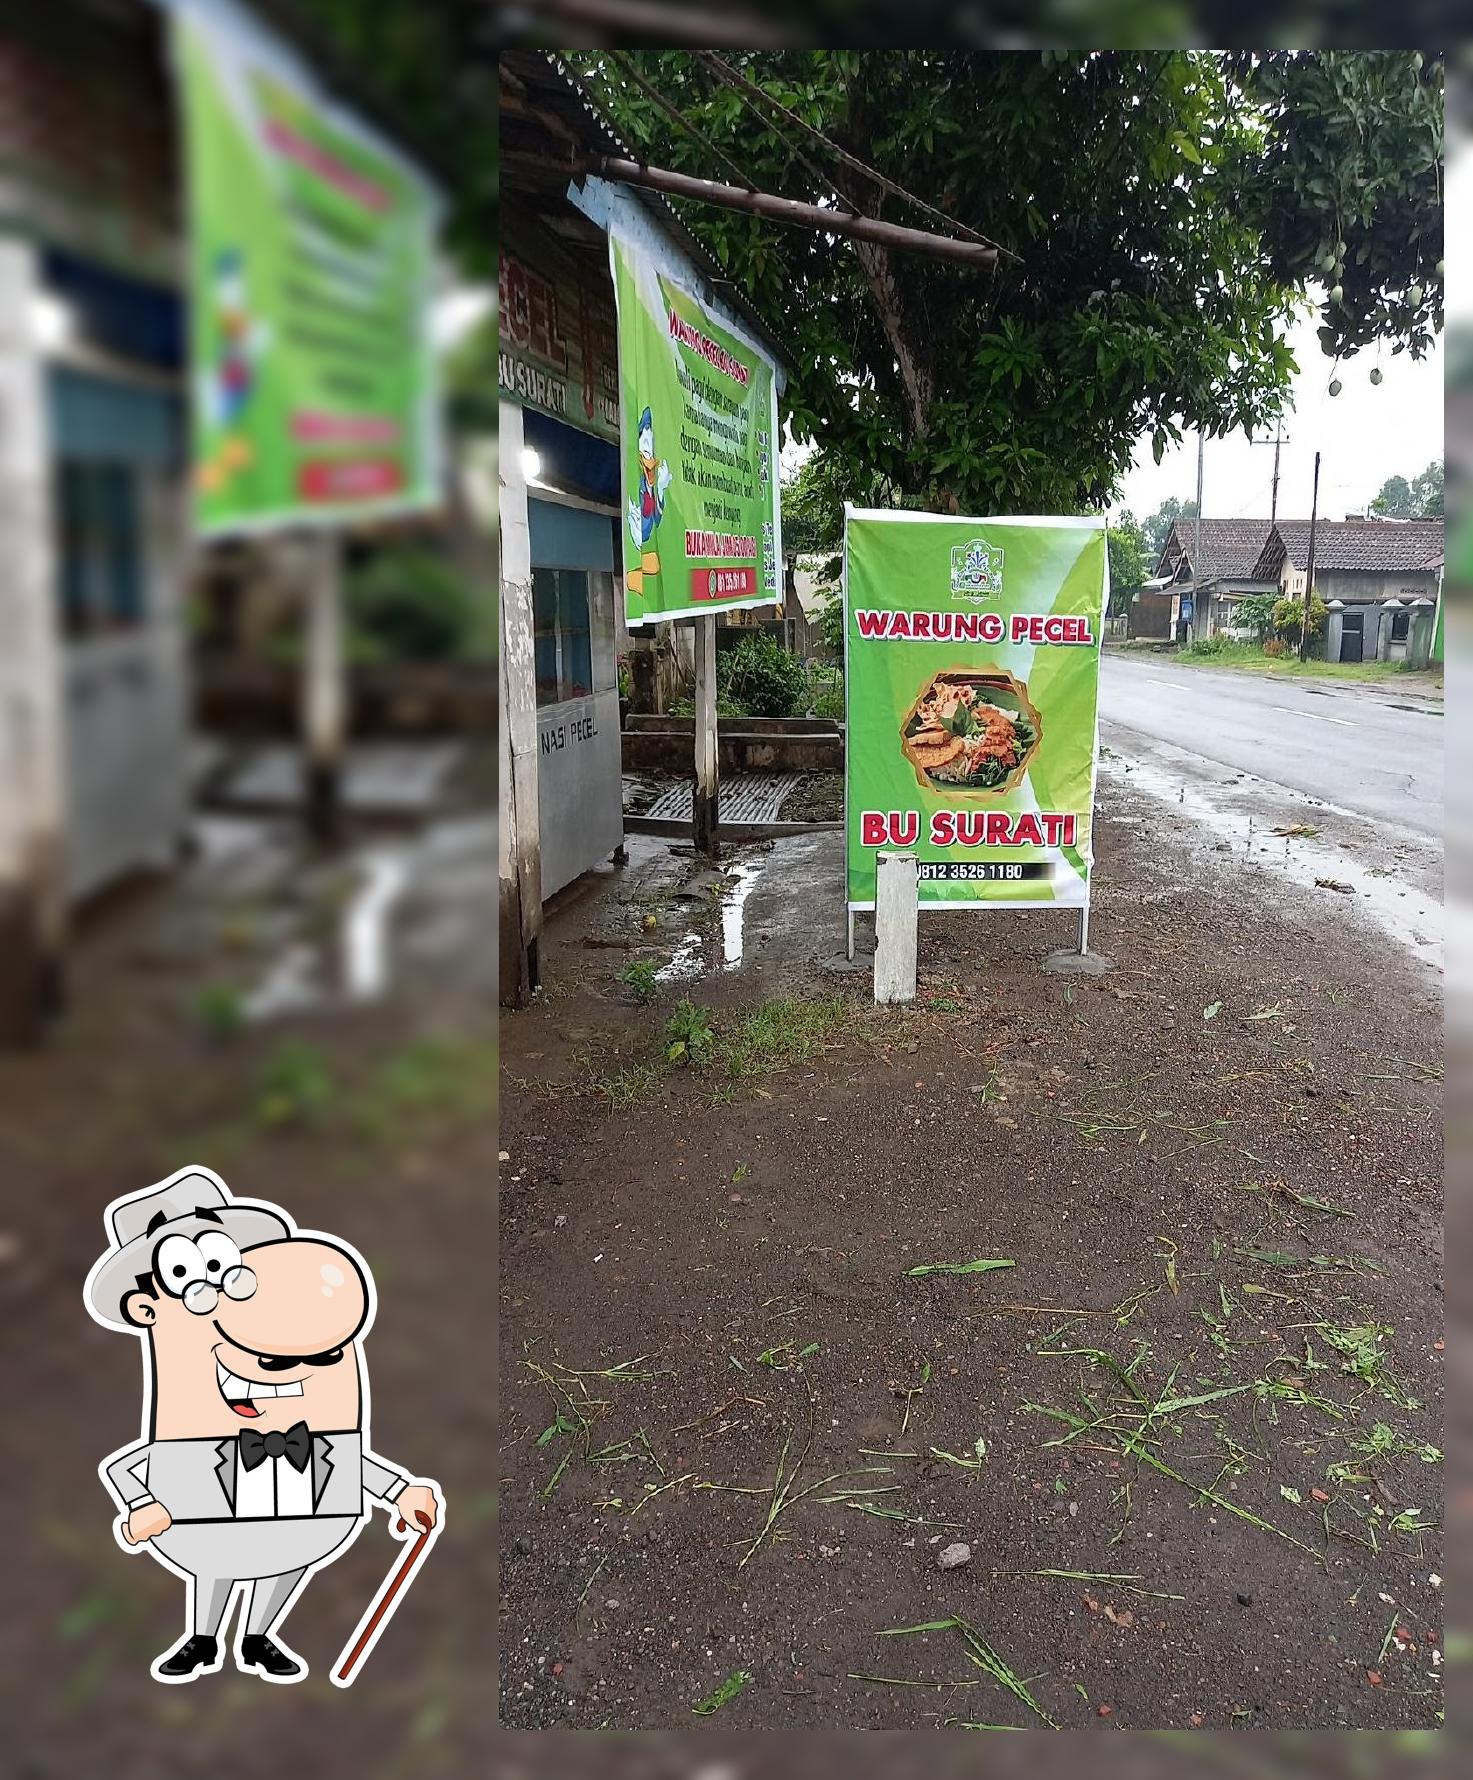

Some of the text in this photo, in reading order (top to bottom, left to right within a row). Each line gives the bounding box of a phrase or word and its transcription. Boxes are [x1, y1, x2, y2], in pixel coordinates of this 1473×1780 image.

[516, 361, 566, 415] SURATI
[857, 611, 1094, 646] WARUNG PECEL
[541, 717, 598, 755] NASI PECEL
[861, 810, 1078, 847] BU SURATI
[950, 864, 985, 880] 3526
[989, 864, 1023, 880] 1180
